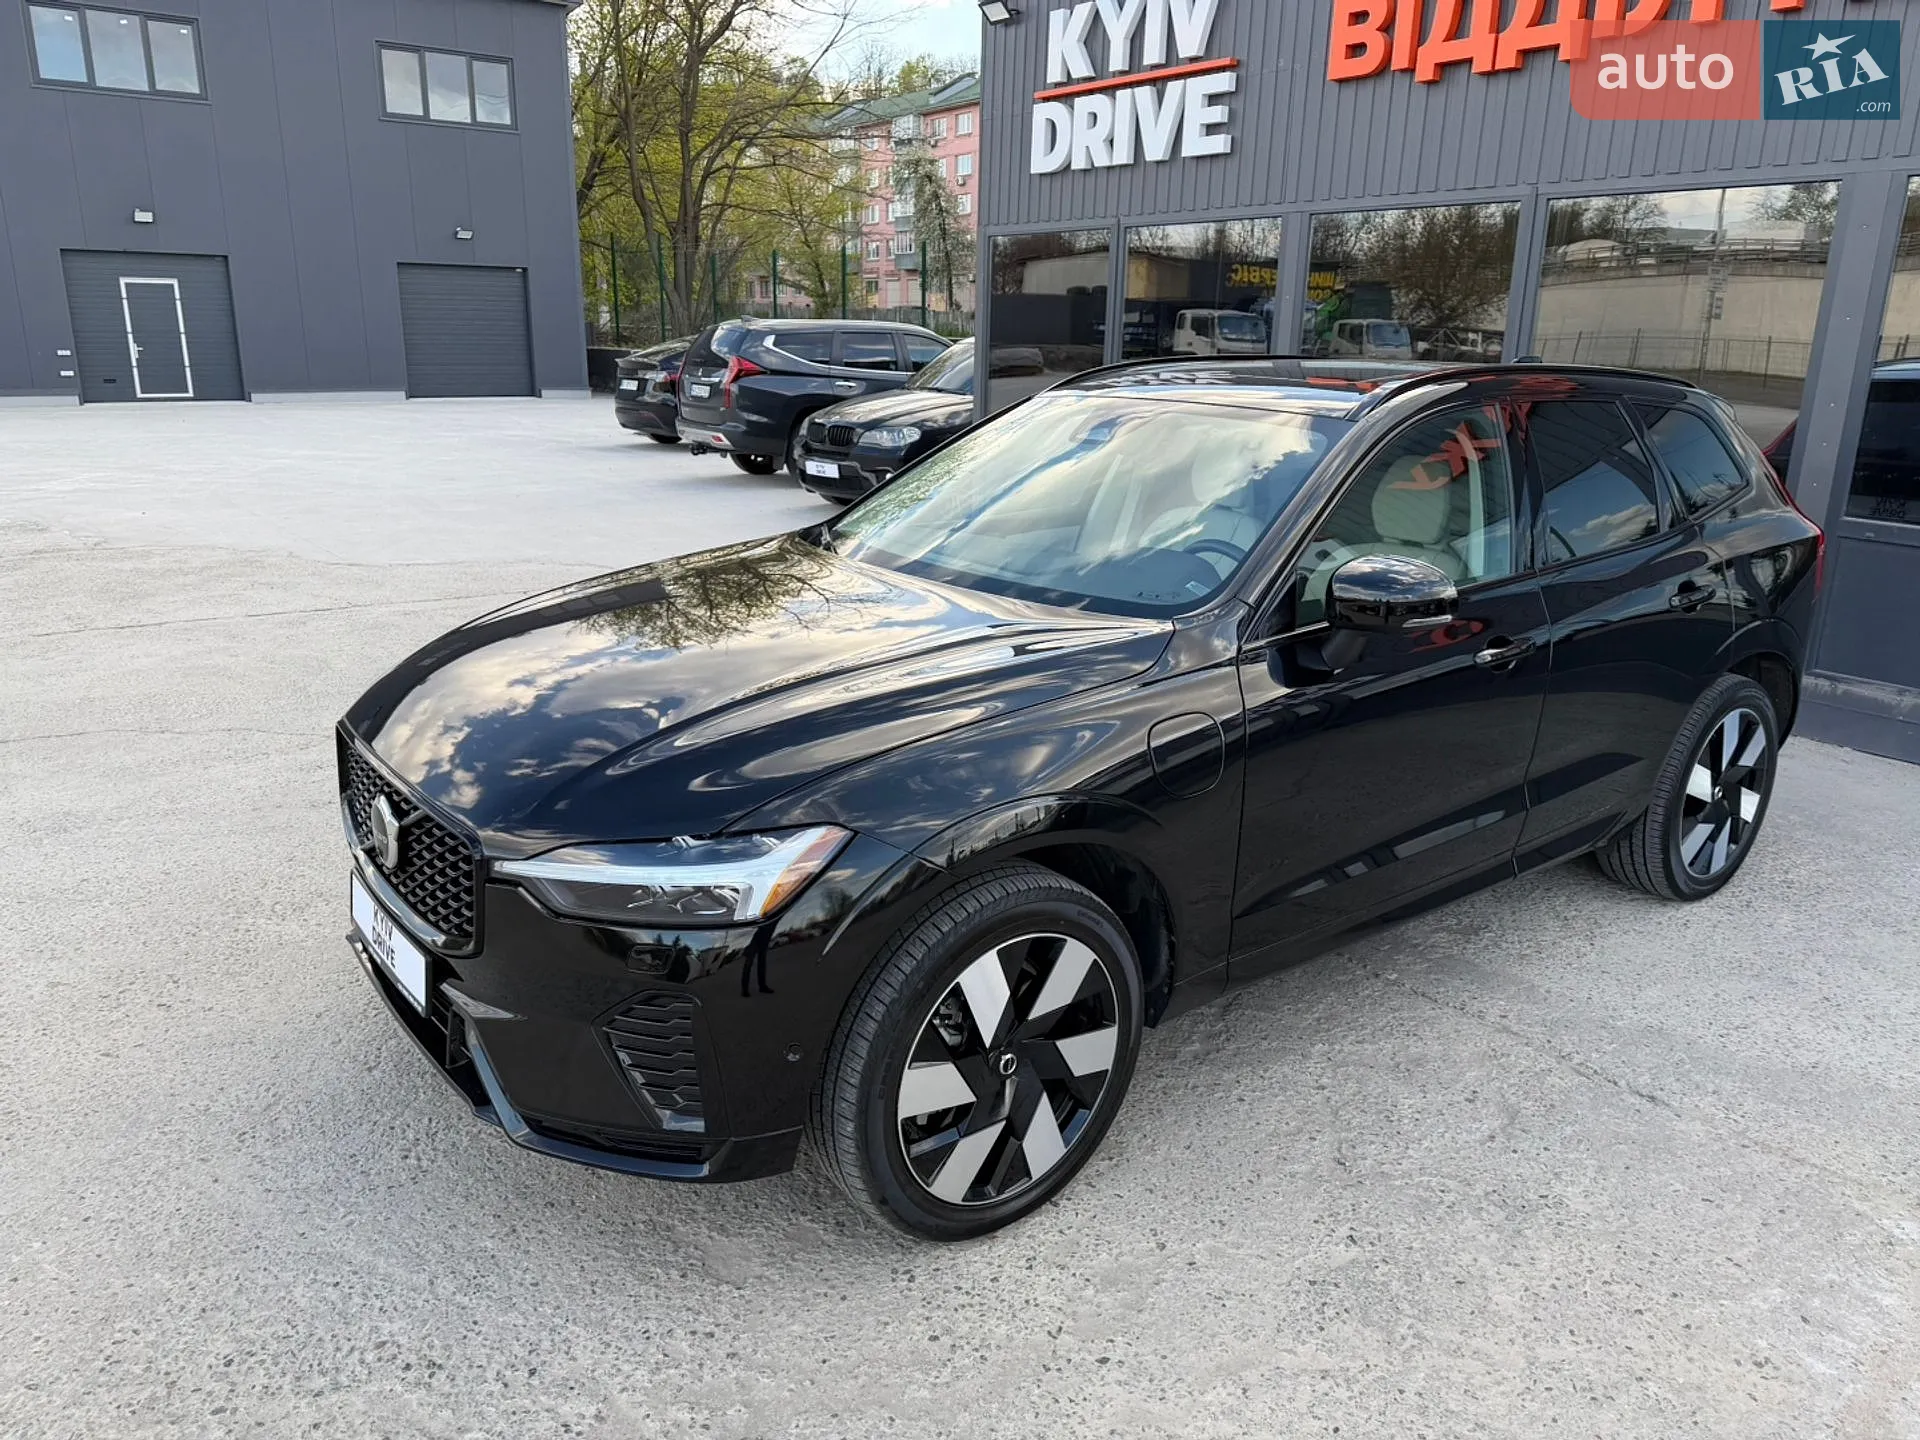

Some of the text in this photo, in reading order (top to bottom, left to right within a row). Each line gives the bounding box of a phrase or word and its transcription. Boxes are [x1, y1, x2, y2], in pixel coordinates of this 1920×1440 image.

[1047, 0, 1218, 84] KYIV
[1030, 71, 1238, 174] DRIVE
[371, 925, 396, 969] DRIVE
[373, 903, 394, 940] KYIV
